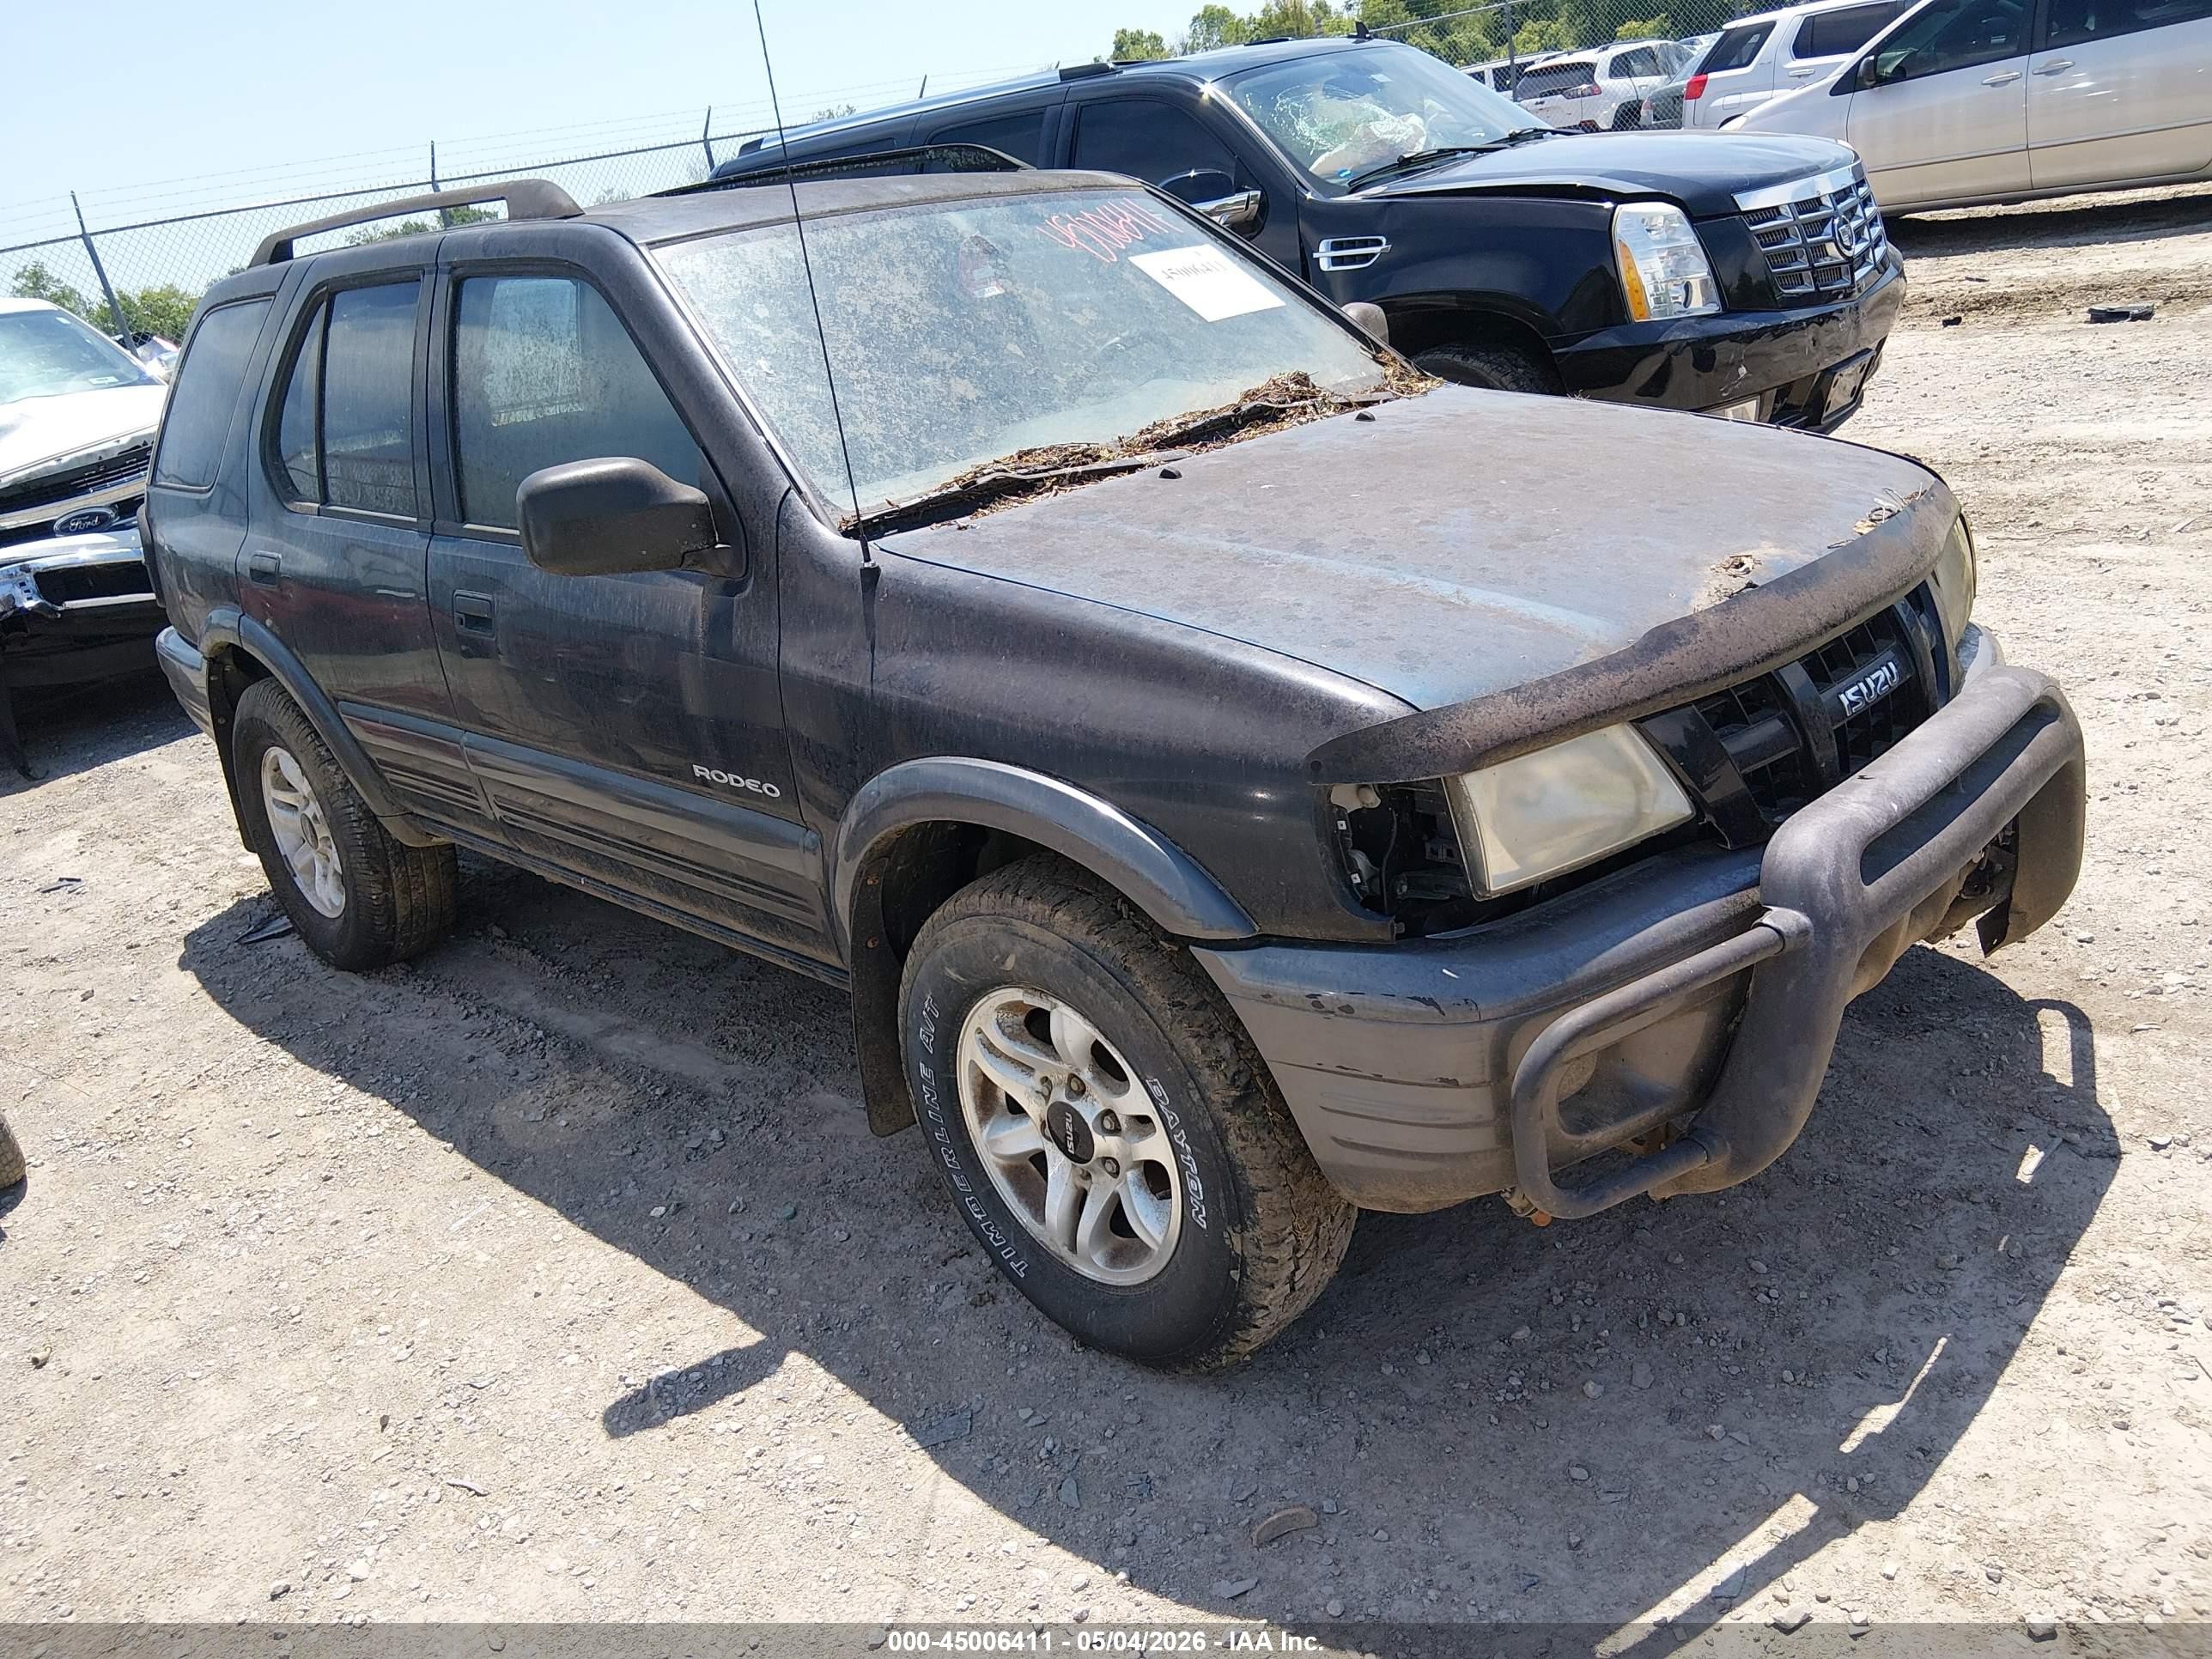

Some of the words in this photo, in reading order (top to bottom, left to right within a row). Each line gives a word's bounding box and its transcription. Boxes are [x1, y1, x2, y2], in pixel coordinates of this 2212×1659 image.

[69, 515, 100, 532] Ford
[1838, 661, 1900, 716] ISUZU
[692, 764, 781, 798] RODEO
[920, 995, 940, 1054] A/T
[1065, 1112, 1075, 1155] ISUZU
[1143, 1078, 1208, 1230] DAYTON
[919, 1061, 1028, 1279] TIMBERLINE
